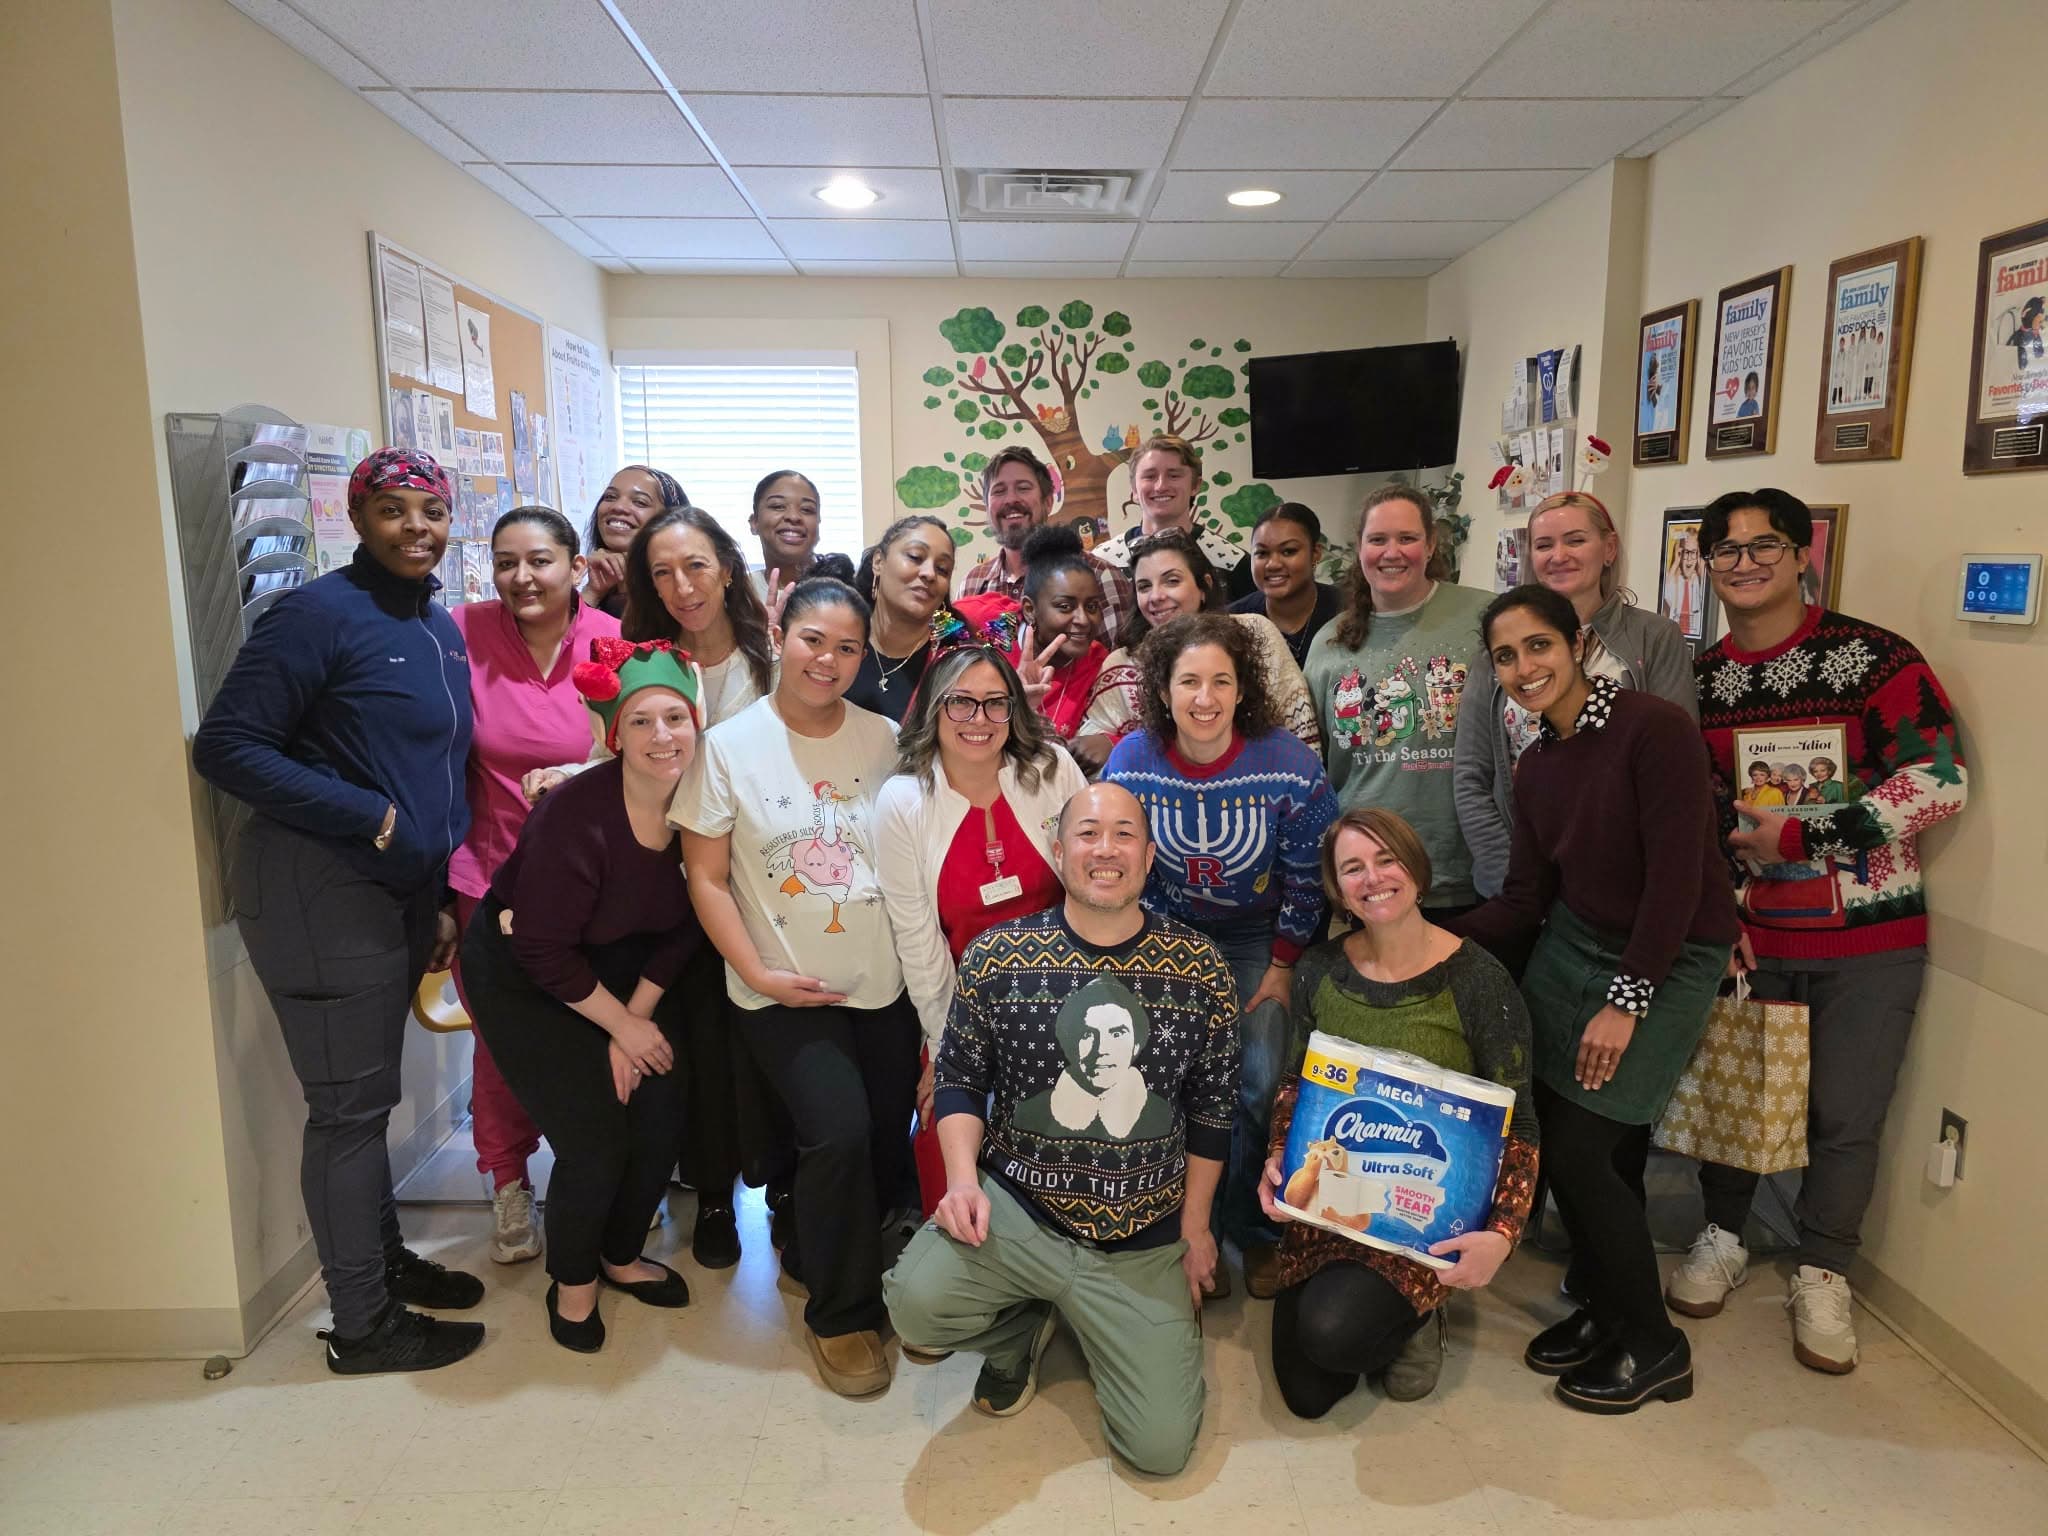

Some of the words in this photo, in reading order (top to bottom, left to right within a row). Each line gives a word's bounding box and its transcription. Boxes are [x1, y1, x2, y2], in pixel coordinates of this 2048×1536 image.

[1840, 283, 1889, 310] family
[1725, 298, 1768, 325] family
[1725, 330, 1740, 343] NEW
[1740, 323, 1766, 341] JERSEY'S
[1855, 319, 1876, 331] DOCS
[1645, 329, 1679, 352] family
[1723, 337, 1764, 360] FAVORITE
[1722, 358, 1742, 374] KIDS'
[1742, 353, 1763, 370] DOCS
[1375, 749, 1397, 763] the
[1748, 742, 1776, 755] Quit
[1799, 740, 1831, 751] Idiot
[760, 830, 798, 856] REGISTERED
[1184, 856, 1228, 887] R
[1312, 1064, 1319, 1075] 9
[1324, 1063, 1348, 1083] 36
[1376, 1082, 1424, 1108] MEGA
[1334, 1111, 1424, 1148] Charmin
[1004, 1160, 1074, 1189] BUDDY
[1088, 1177, 1128, 1198] THE
[1137, 1168, 1164, 1190] ELF
[1361, 1160, 1400, 1175] Ultra
[1402, 1163, 1435, 1181] Soft
[1394, 1195, 1432, 1215] TEAR
[1395, 1185, 1435, 1204] SMOOTH
